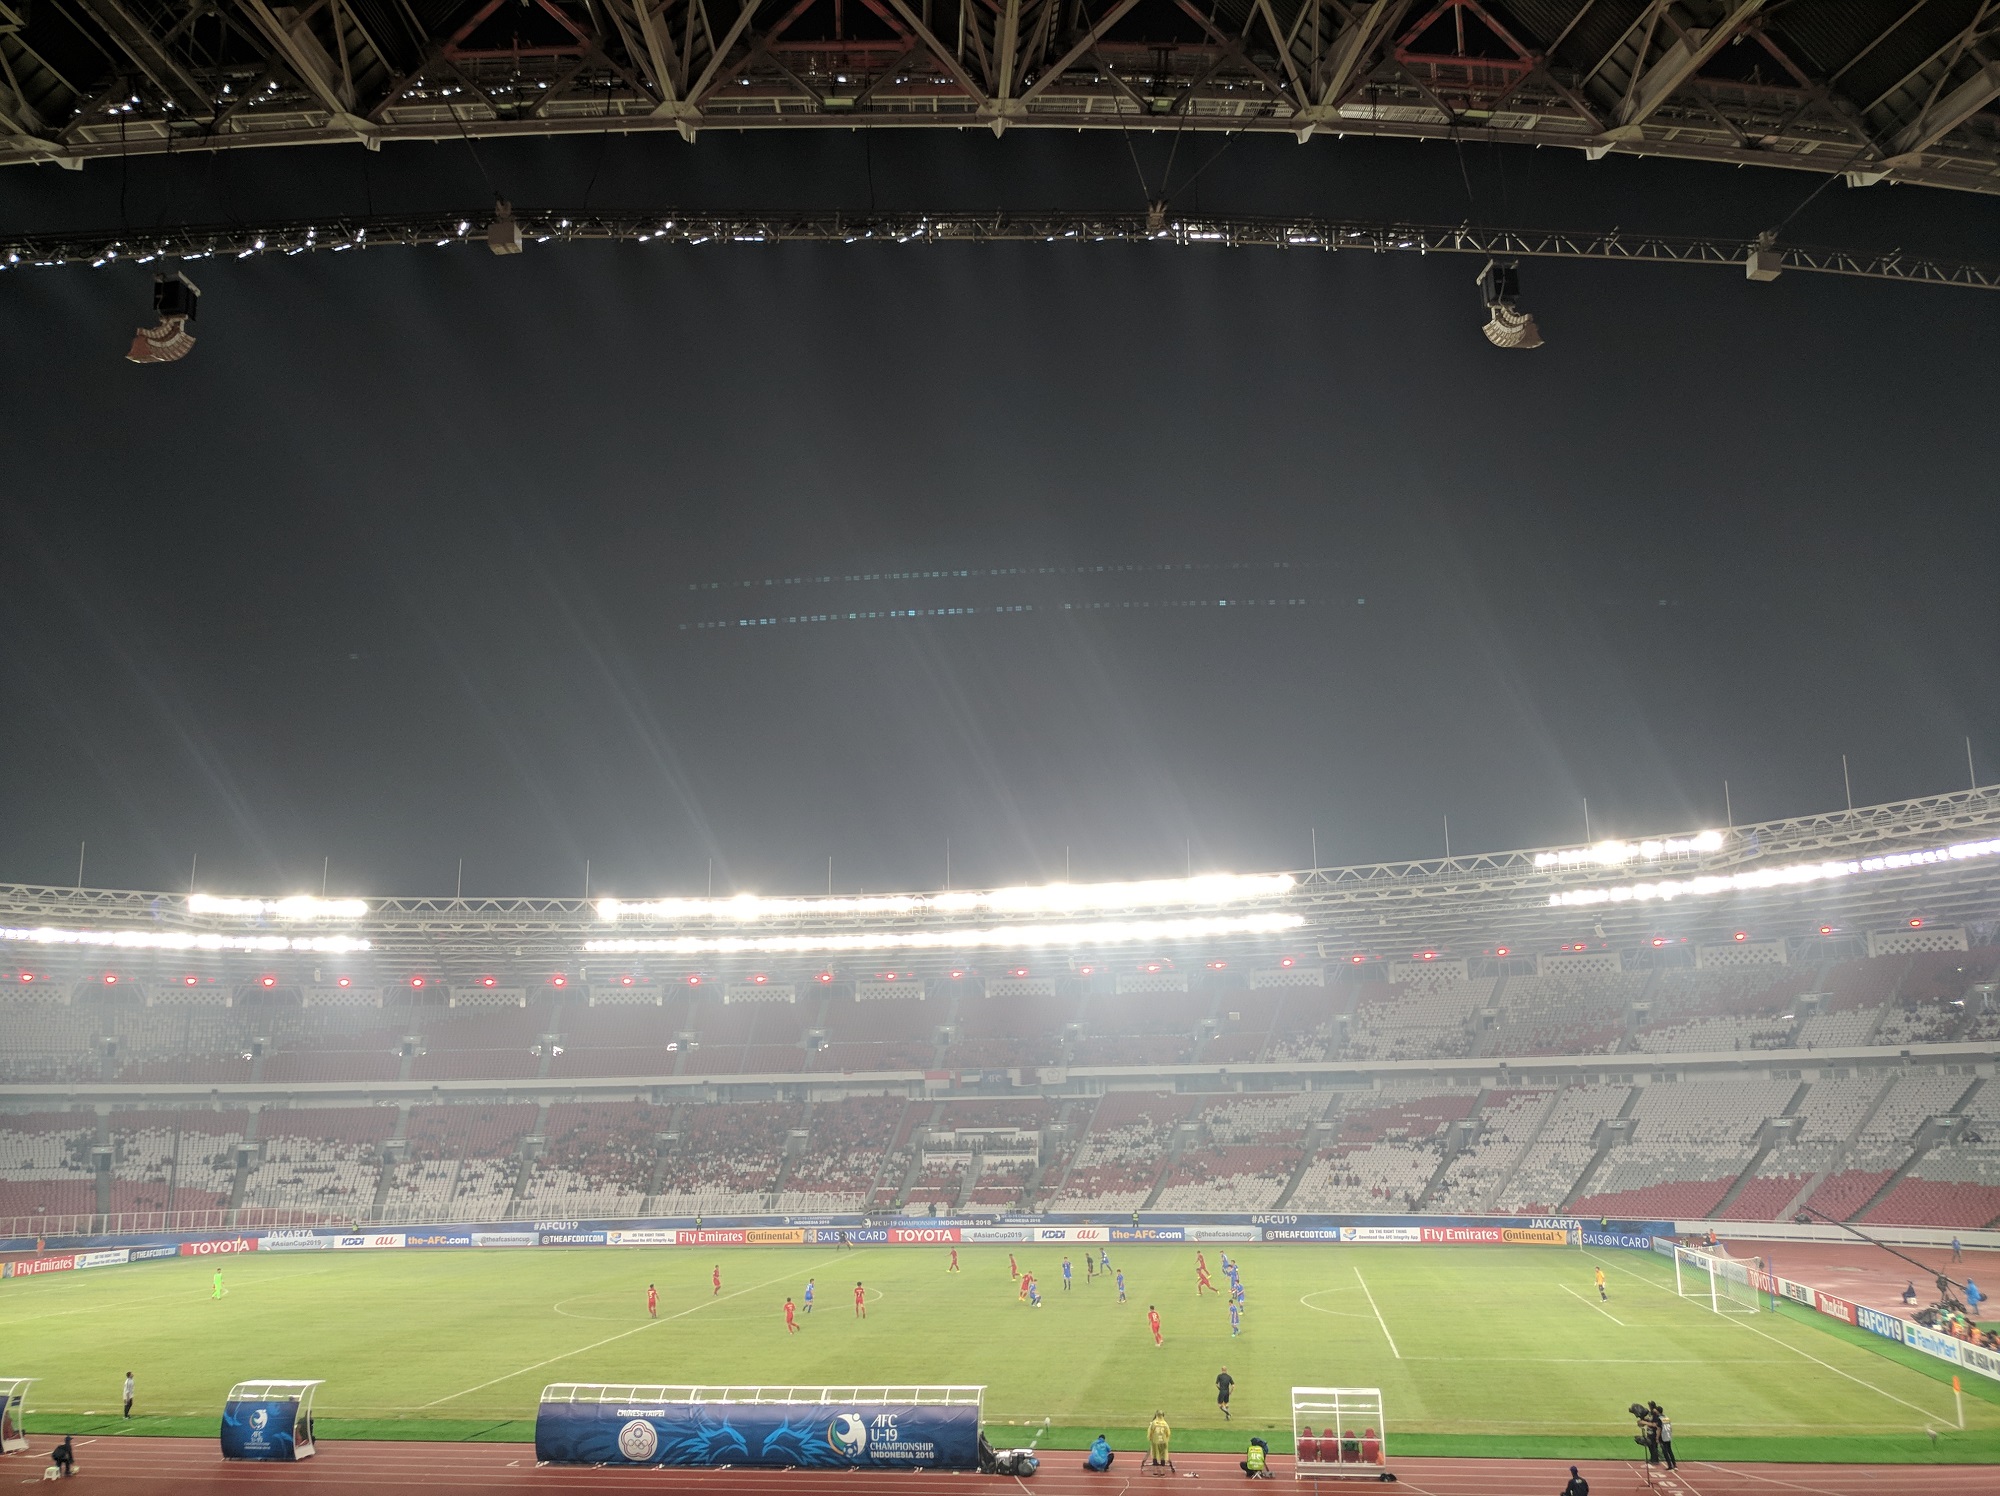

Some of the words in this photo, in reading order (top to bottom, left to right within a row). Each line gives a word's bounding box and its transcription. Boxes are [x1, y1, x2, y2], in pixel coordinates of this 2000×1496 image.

[1251, 1215, 1298, 1224] #AFCU19
[1529, 1218, 1581, 1229] JAKARTA
[534, 1221, 579, 1231] #AFCU19
[265, 1229, 314, 1239] JAKARTA
[679, 1232, 697, 1244] Fly
[699, 1231, 743, 1243] Emirates
[746, 1231, 794, 1243] Continental
[858, 1231, 887, 1241] CARD
[896, 1229, 953, 1241] TOYOTA
[973, 1231, 1022, 1240] #AsianCup2019
[1042, 1230, 1066, 1239] KDDI
[1077, 1230, 1099, 1239] au
[1112, 1229, 1182, 1239] the-AFC.com
[1195, 1230, 1252, 1239] @theafcasiancup
[1266, 1230, 1336, 1240] @THEAFCDOTCOM
[1423, 1229, 1444, 1241] Fly
[1446, 1228, 1499, 1240] Emirates
[1503, 1230, 1555, 1241] Continental
[271, 1239, 321, 1248] #AsianCup2019
[341, 1237, 365, 1246] KDDI
[375, 1236, 398, 1246] au
[407, 1235, 470, 1246] the-AFC.com
[1582, 1233, 1620, 1246] SAISON
[1621, 1236, 1649, 1249] CARD
[191, 1240, 250, 1255] TOYOTA
[17, 1262, 33, 1275] Fly
[34, 1258, 73, 1273] Emirates
[1857, 1307, 1902, 1342] #AFCU19
[1917, 1330, 1958, 1360] FamilyMart
[617, 1409, 644, 1417] CHINESE
[644, 1409, 666, 1417] TAIPEI
[870, 1413, 898, 1428] AFC
[870, 1428, 898, 1442] U-19
[869, 1442, 934, 1451] CHAMPIONSHIP
[870, 1451, 914, 1459] INDONESIA
[915, 1451, 935, 1459] 2018
